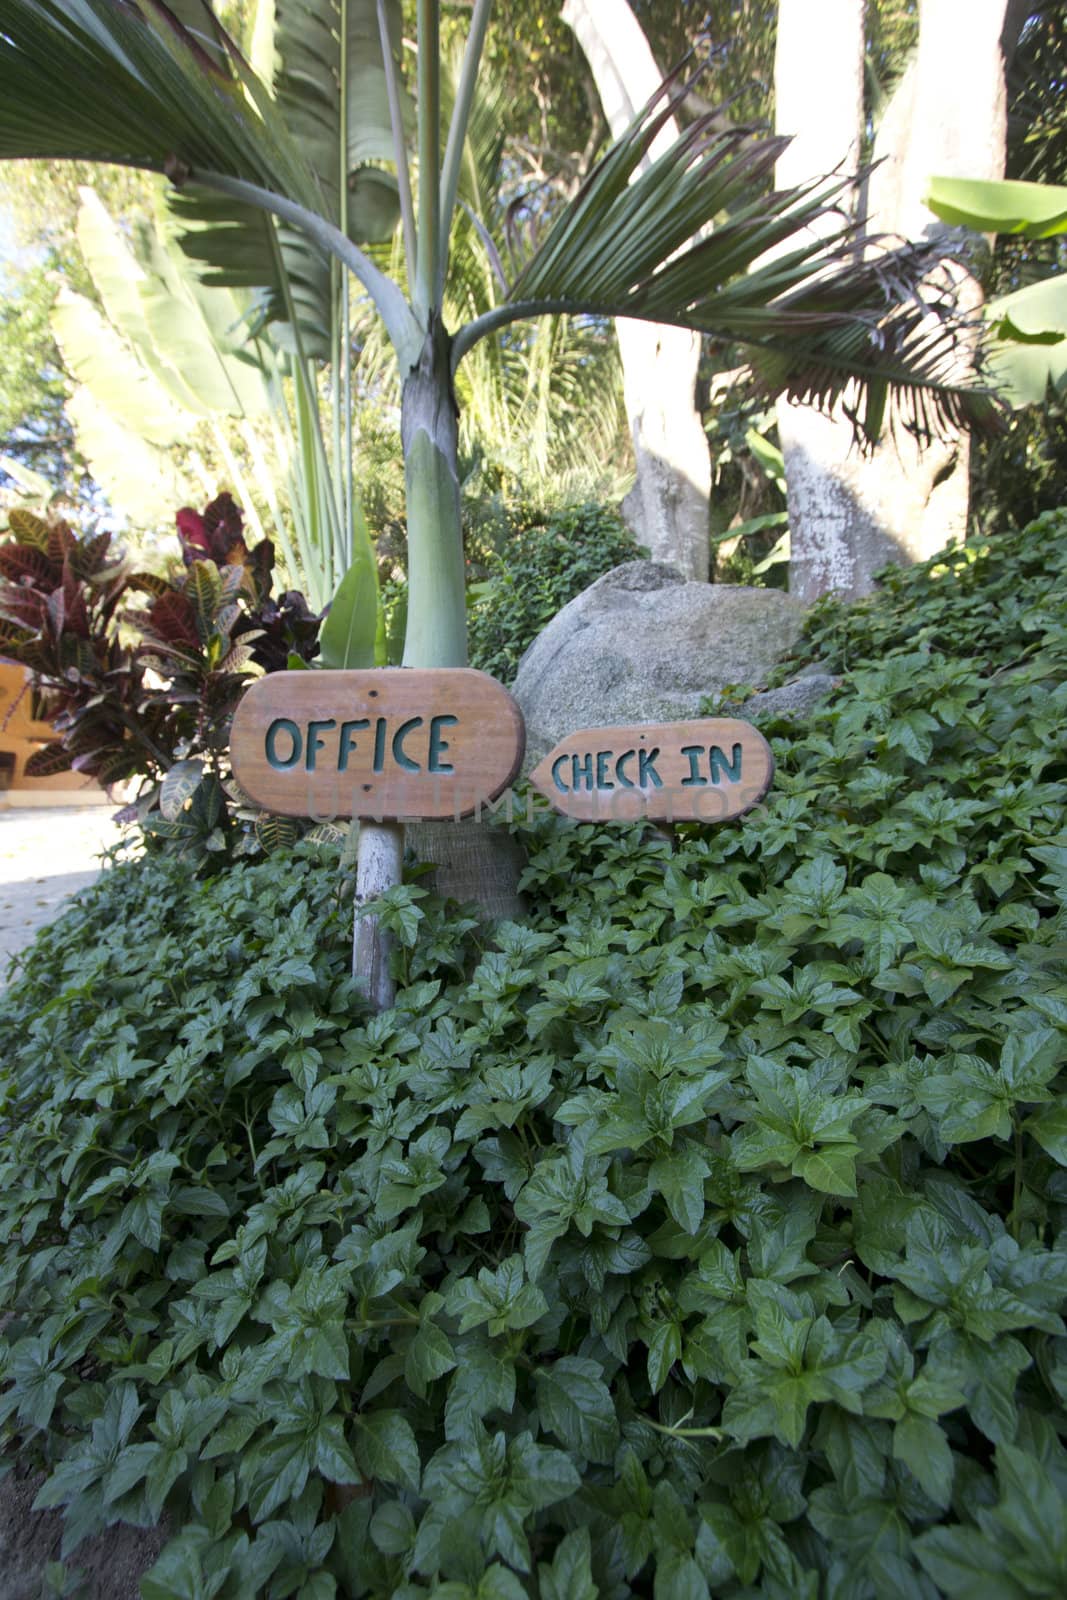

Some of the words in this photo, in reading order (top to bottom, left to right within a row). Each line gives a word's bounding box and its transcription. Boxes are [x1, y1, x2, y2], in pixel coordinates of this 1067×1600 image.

[264, 714, 459, 774] OFFICE
[551, 747, 664, 792] CHECK
[680, 742, 743, 786] IN
